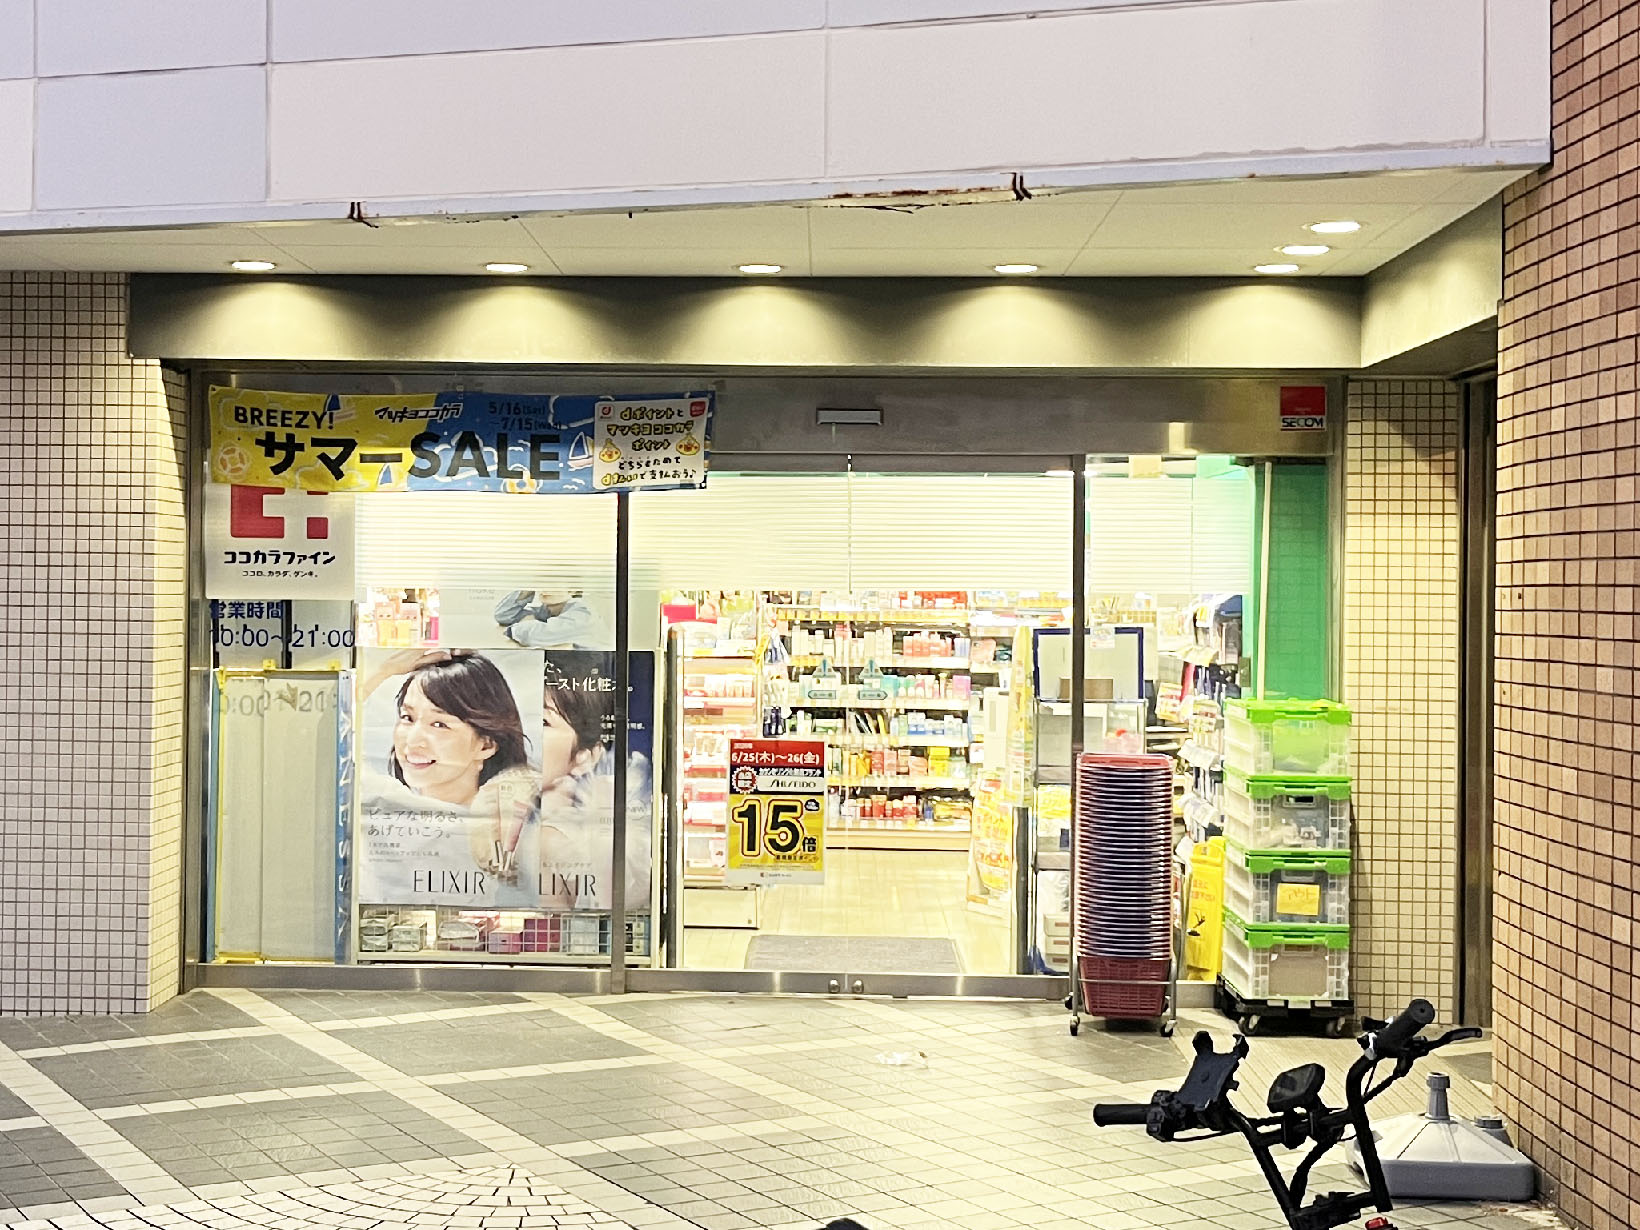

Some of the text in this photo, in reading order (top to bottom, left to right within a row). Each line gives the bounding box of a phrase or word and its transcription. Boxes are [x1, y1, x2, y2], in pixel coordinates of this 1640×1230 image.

[233, 405, 335, 430] BREEZY!
[1281, 417, 1323, 428] SECOM
[606, 420, 694, 436] マツキヨココカラ
[631, 437, 671, 451] ポイント
[223, 549, 336, 565] ココカラファイン
[209, 600, 284, 620] 営業時間
[544, 676, 634, 692] ースト化粧。
[731, 750, 820, 765] 6/25(木)～26(金)
[367, 824, 451, 839] あげていこう。
[413, 869, 486, 895] ELIXIR
